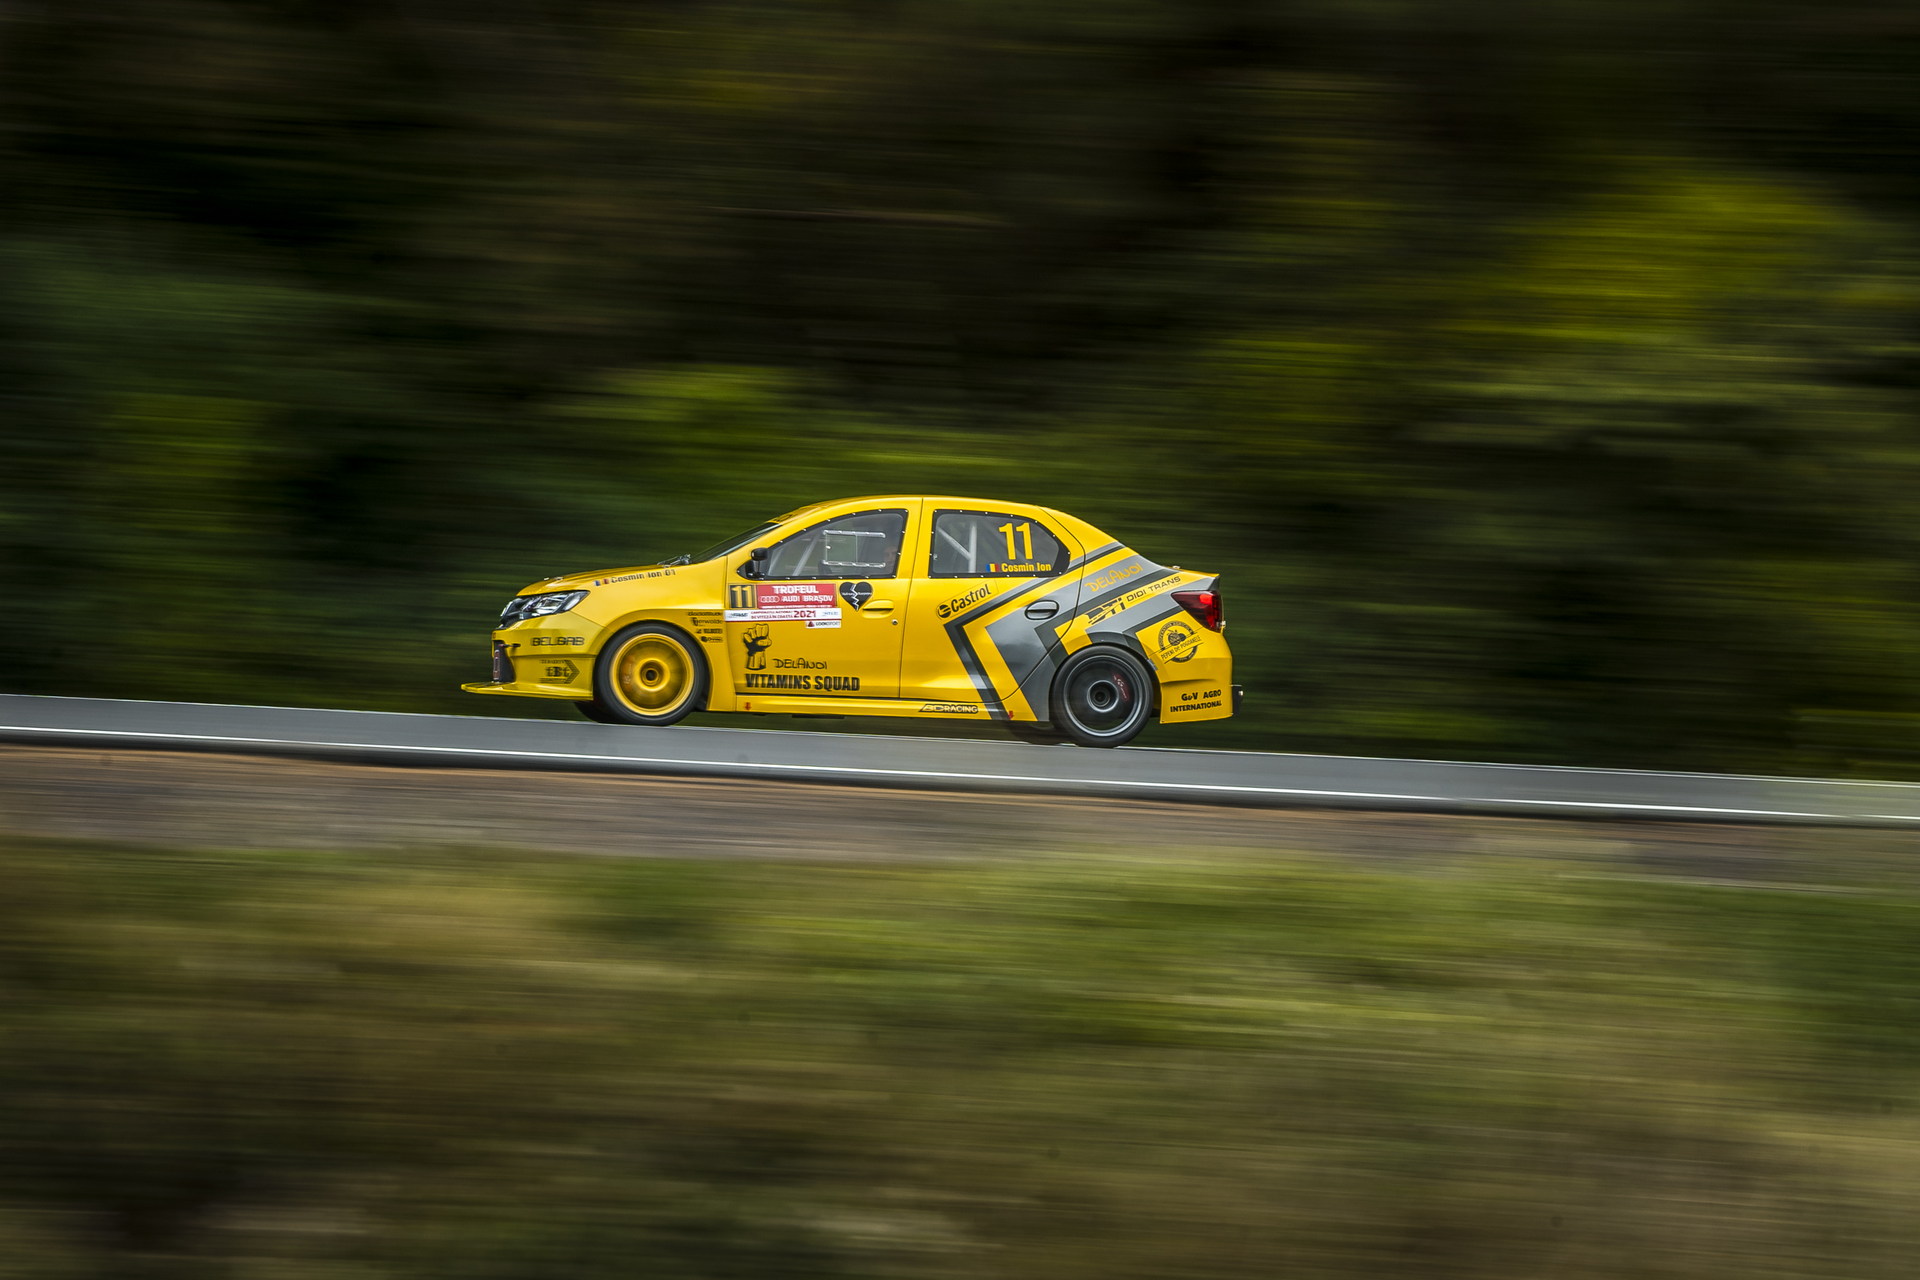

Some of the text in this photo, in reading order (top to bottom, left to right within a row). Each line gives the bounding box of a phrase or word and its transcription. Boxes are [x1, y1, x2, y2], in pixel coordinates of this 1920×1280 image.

[999, 522, 1033, 560] 11
[1001, 562, 1052, 572] Cosmin Ion
[611, 573, 645, 584] Cosmin
[1084, 562, 1144, 592] DELANOI
[772, 585, 819, 594] TROFEUL
[1126, 576, 1182, 602] DIDI TRANS
[730, 585, 753, 608] 11
[781, 595, 800, 603] AUDI
[950, 583, 992, 613] Castrol
[794, 610, 817, 618] 2021
[773, 658, 828, 669] DELANOI
[745, 673, 860, 692] VITAMINS SQUAD
[1203, 689, 1222, 699] AGRO
[1170, 700, 1223, 713] INTERNATIONAL
